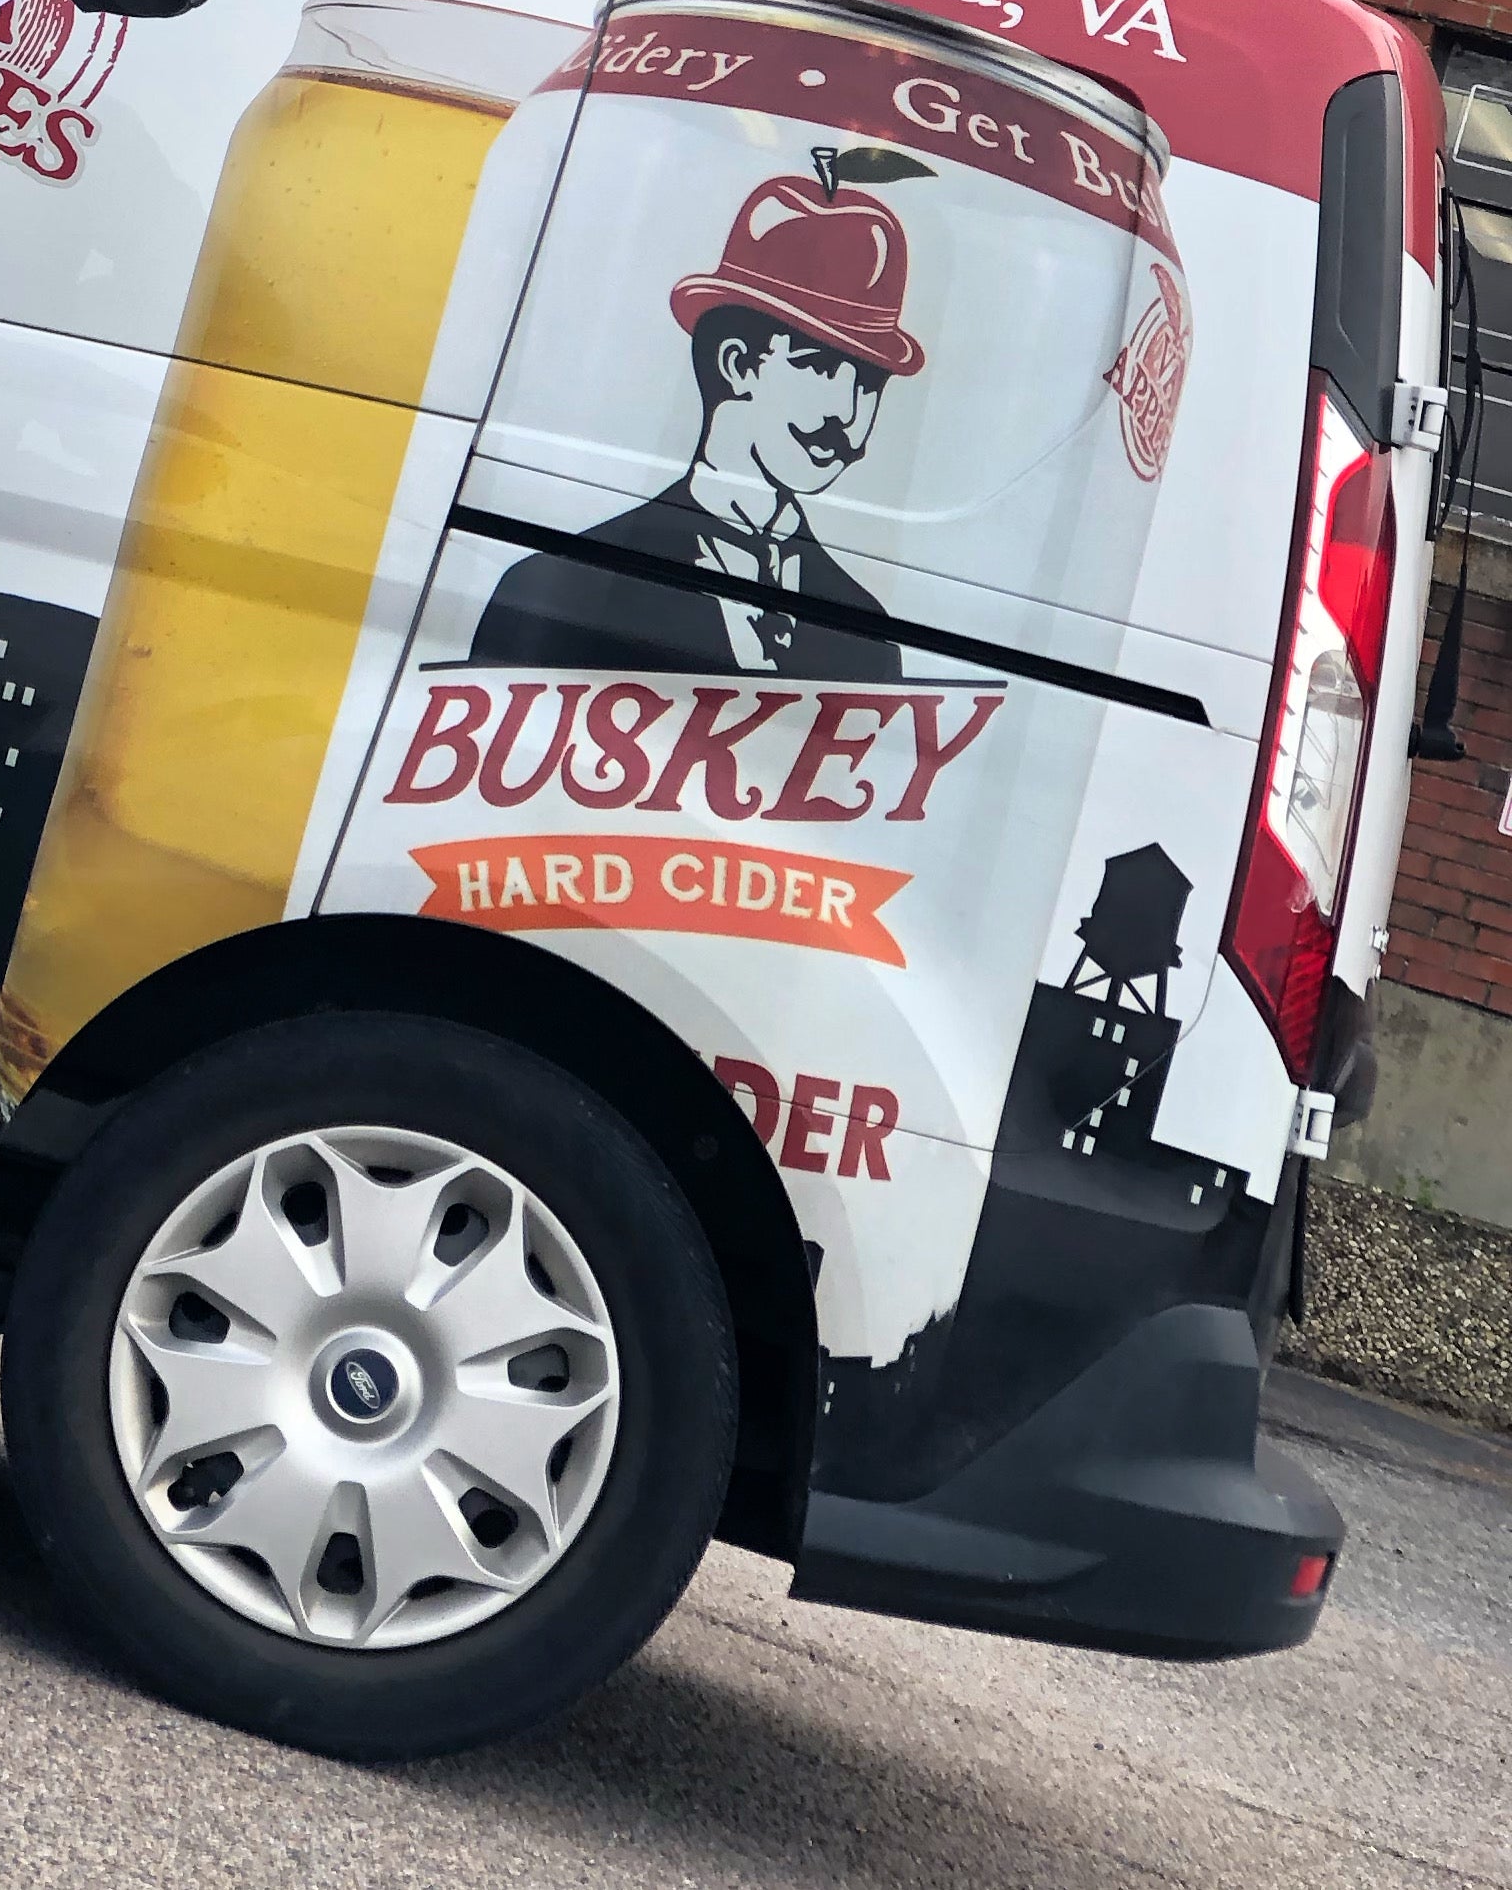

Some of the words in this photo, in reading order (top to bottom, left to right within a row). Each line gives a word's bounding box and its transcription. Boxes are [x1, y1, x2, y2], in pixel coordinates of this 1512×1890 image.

[892, 76, 1035, 166] Get
[383, 683, 1005, 821] BUSKEY
[456, 853, 633, 913] HARD
[660, 853, 858, 930] CIDER
[692, 1049, 899, 1182] DER
[350, 1371, 376, 1401] Ford
